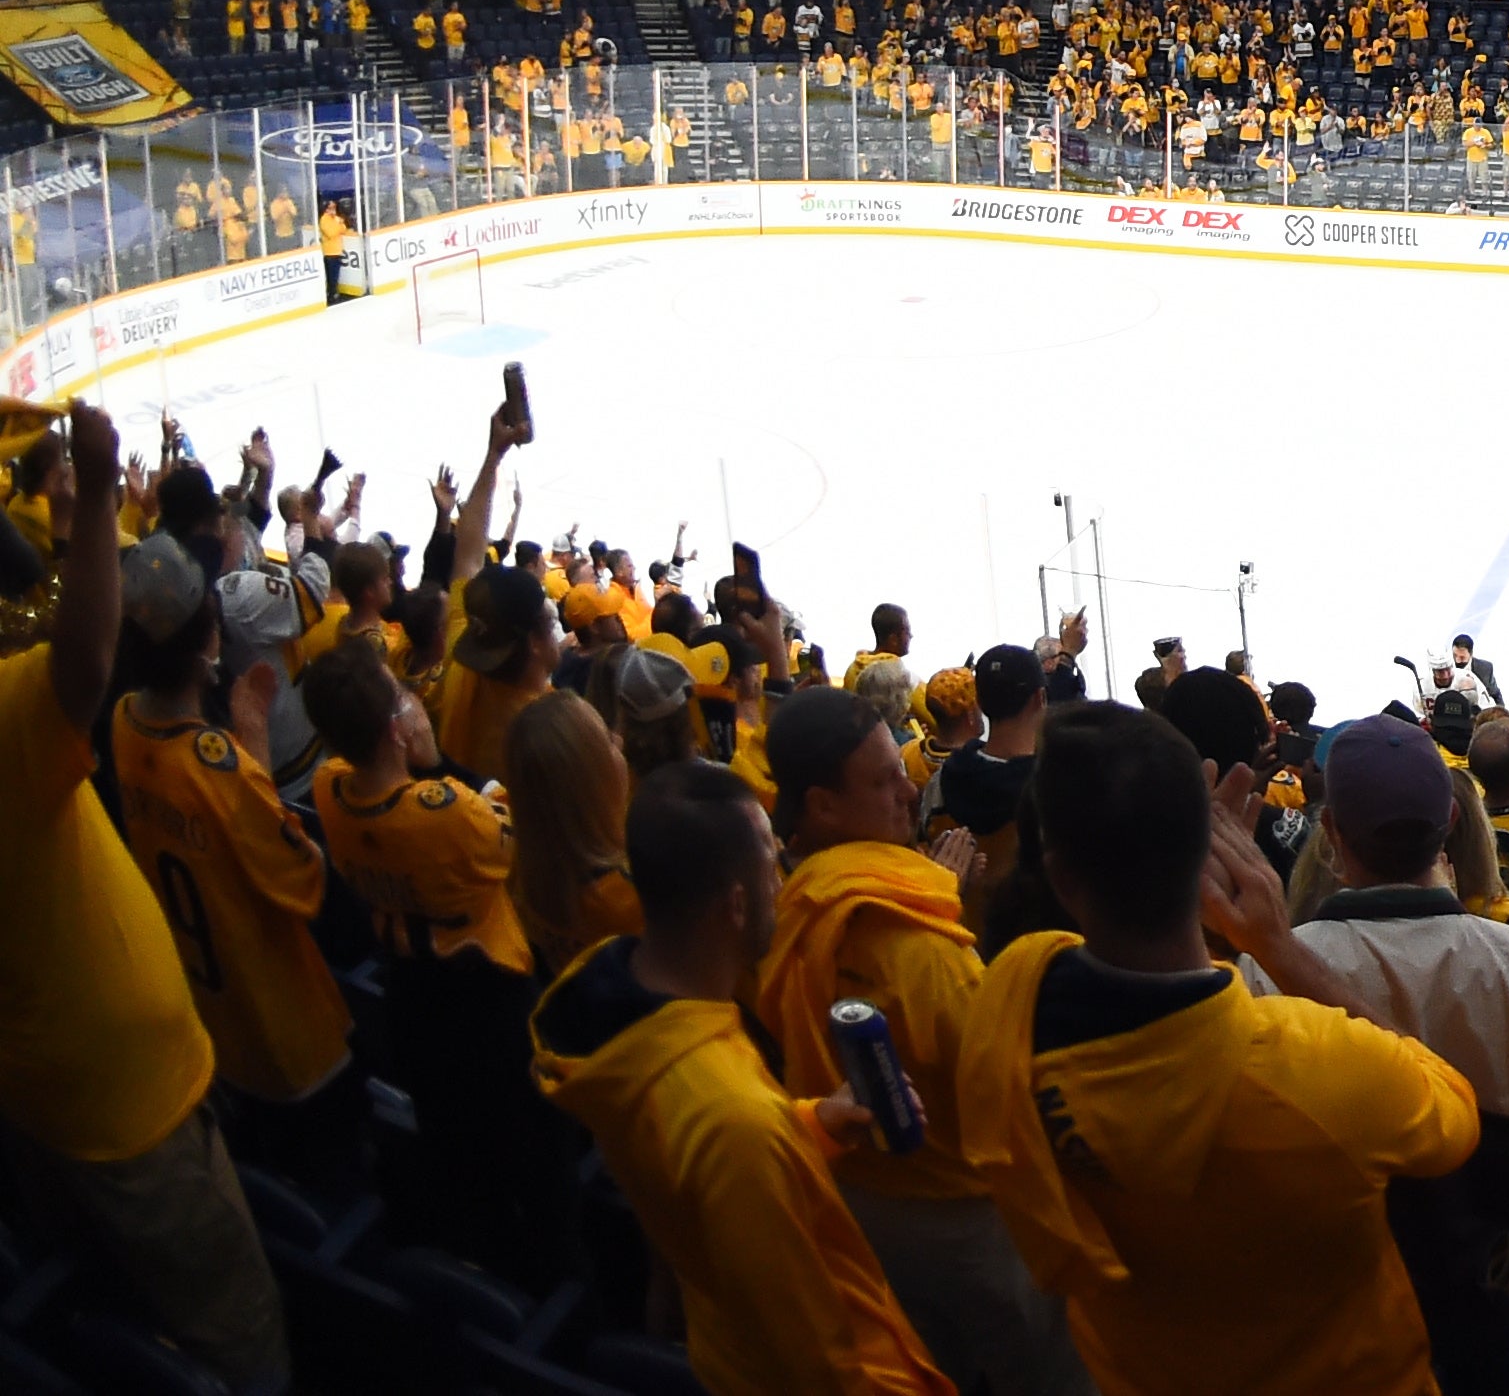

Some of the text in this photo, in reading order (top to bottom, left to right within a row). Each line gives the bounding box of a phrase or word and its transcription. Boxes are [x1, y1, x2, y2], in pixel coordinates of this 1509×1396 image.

[25, 40, 92, 72] BUILT
[64, 79, 130, 104] TOUGH
[294, 129, 394, 157] Ford
[577, 199, 648, 229] xfinity
[825, 211, 902, 222] SPORTSBOOK
[951, 198, 1084, 226] BRIDGESTONE
[1107, 204, 1245, 232] DEX DEX
[465, 216, 542, 248] Lochinvar
[1121, 224, 1251, 243] imaging imaging
[1323, 222, 1420, 247] COOPER STEEL
[385, 235, 427, 264] Clips
[219, 257, 320, 298] NAVY FEDERAL
[122, 315, 179, 345] DELIVERY
